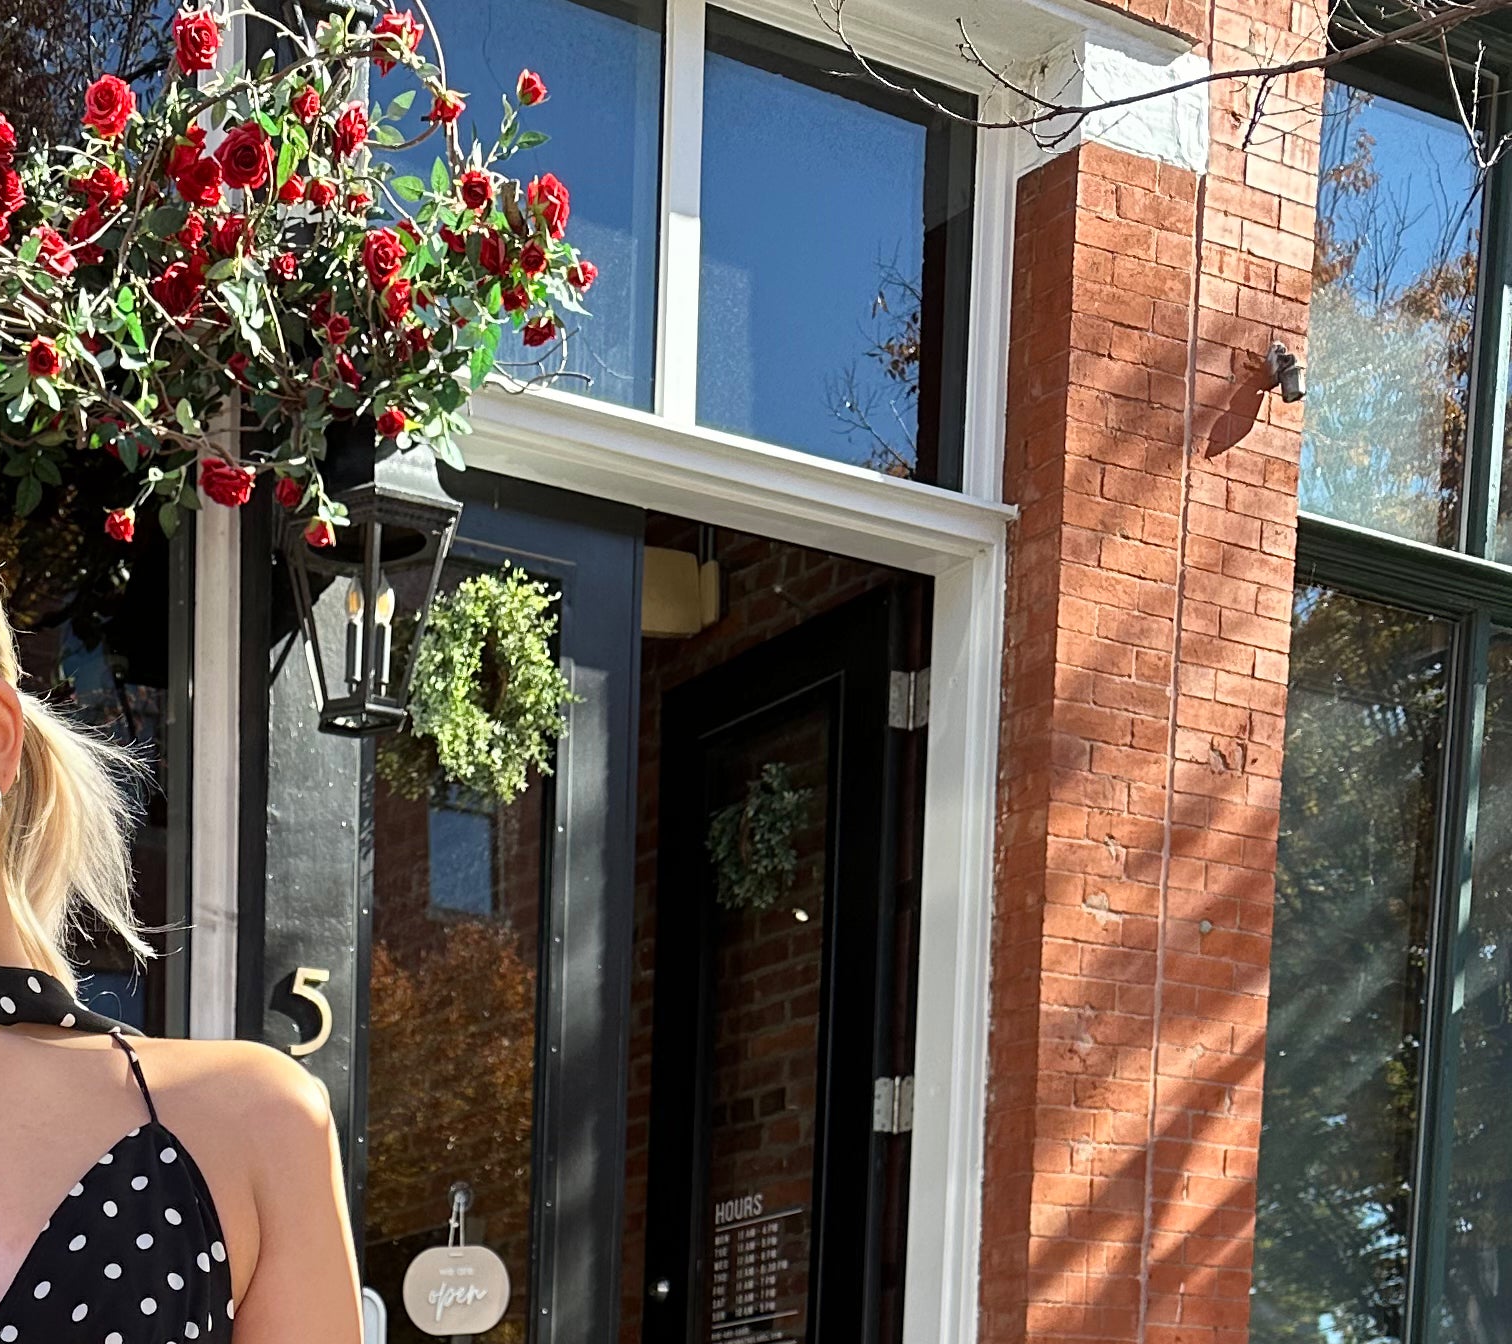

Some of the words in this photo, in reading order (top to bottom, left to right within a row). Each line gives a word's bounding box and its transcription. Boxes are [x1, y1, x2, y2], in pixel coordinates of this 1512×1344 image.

[289, 967, 333, 1056] 5
[715, 1193, 763, 1225] HOURS
[428, 1281, 488, 1322] open
